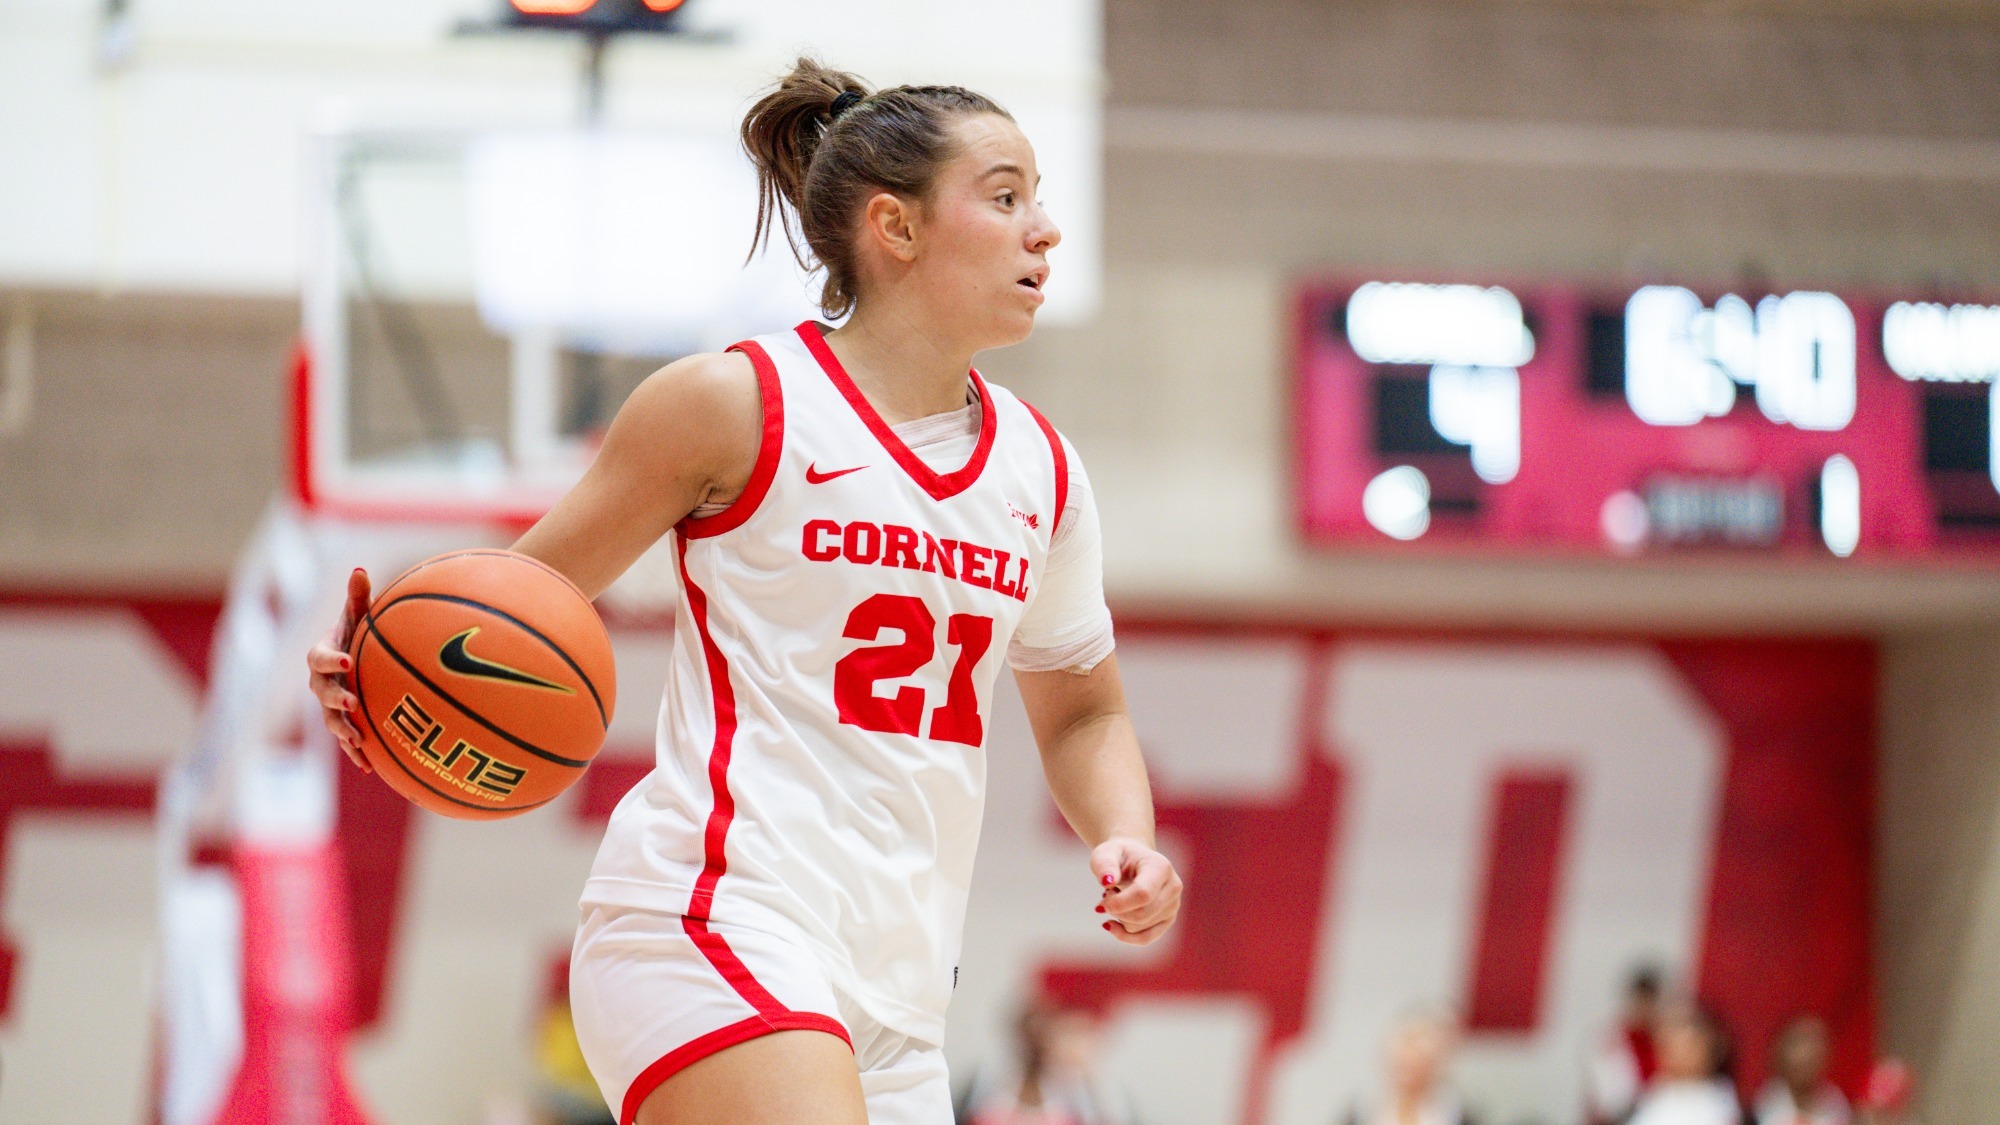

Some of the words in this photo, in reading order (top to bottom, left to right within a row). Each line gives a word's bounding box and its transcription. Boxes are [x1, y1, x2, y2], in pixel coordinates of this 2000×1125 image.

[802, 519, 1029, 602] CORNELL
[834, 593, 993, 748] 21
[383, 719, 506, 802] CHAMPIONSHIP
[388, 692, 528, 796] ELITE
